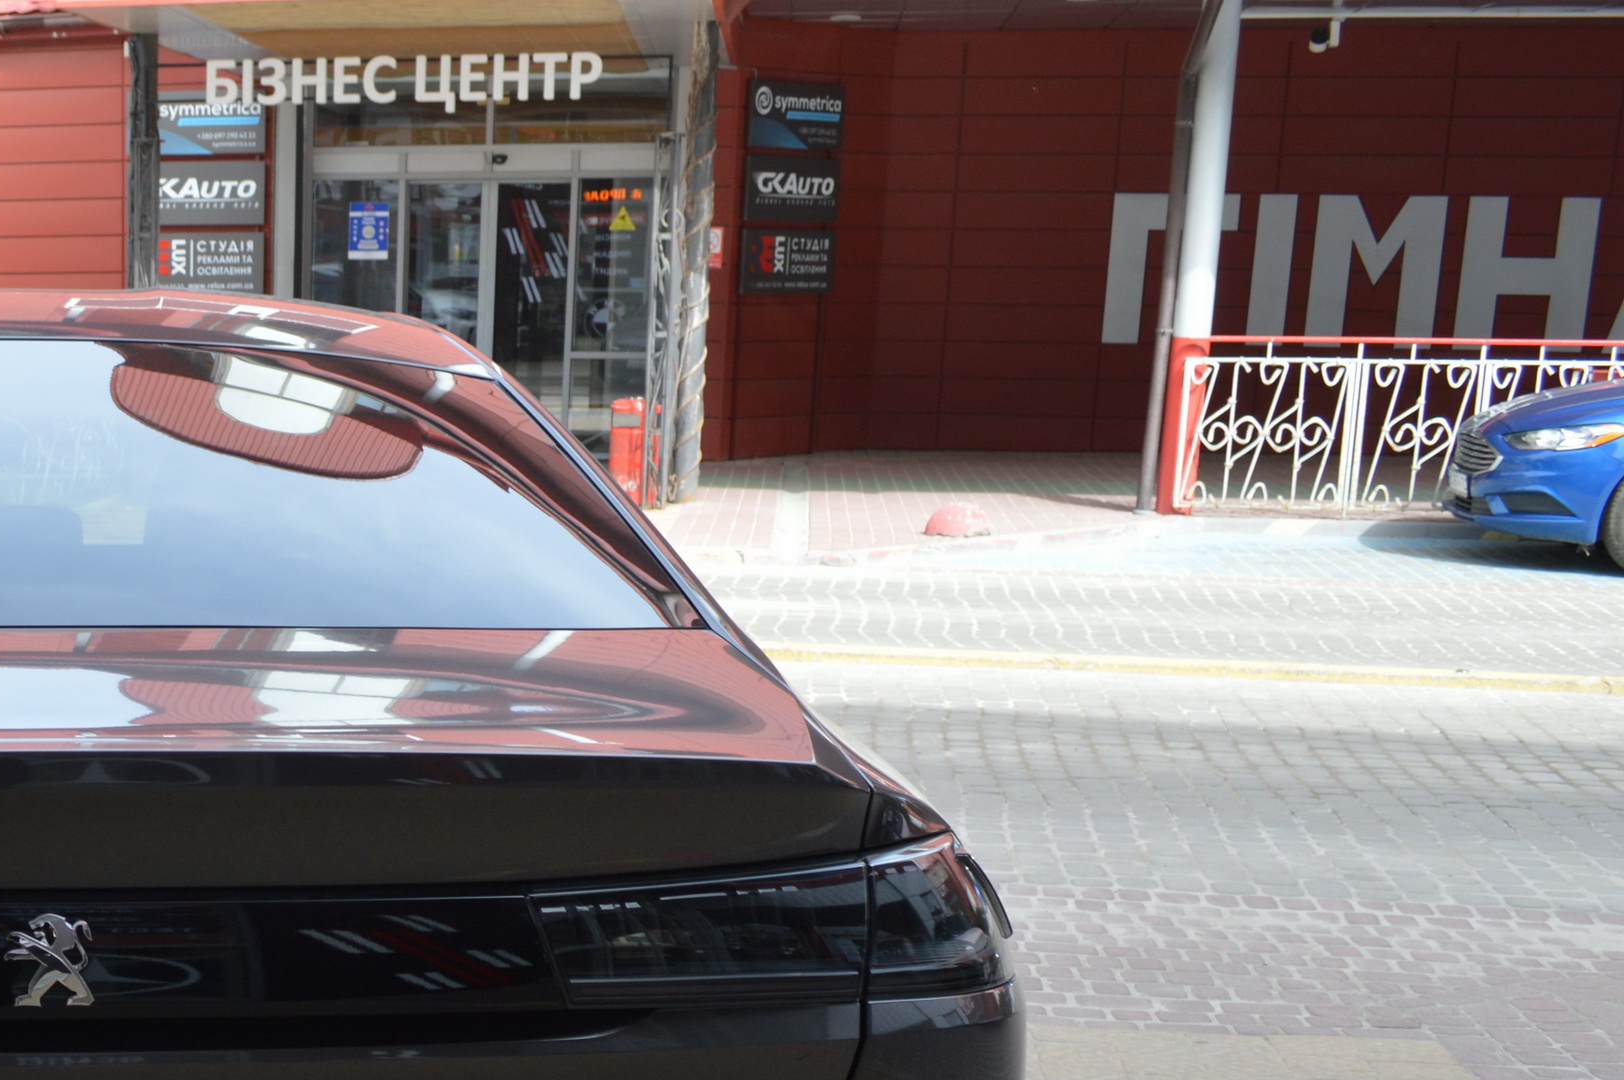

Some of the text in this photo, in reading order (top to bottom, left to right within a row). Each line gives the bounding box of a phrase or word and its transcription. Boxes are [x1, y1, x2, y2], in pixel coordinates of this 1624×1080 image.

[205, 51, 604, 114] БІЗНЕС ЦЕНТР
[159, 101, 261, 121] symmetrica
[774, 95, 842, 113] symmetrica
[196, 239, 254, 254] СТУДІЯ
[792, 237, 830, 252] СТУДІЯ
[196, 255, 254, 265] РЕКЛАМИ ТА
[196, 266, 253, 277] ОСВІТЛЕННЯ
[1100, 192, 1624, 353] ГІМН
